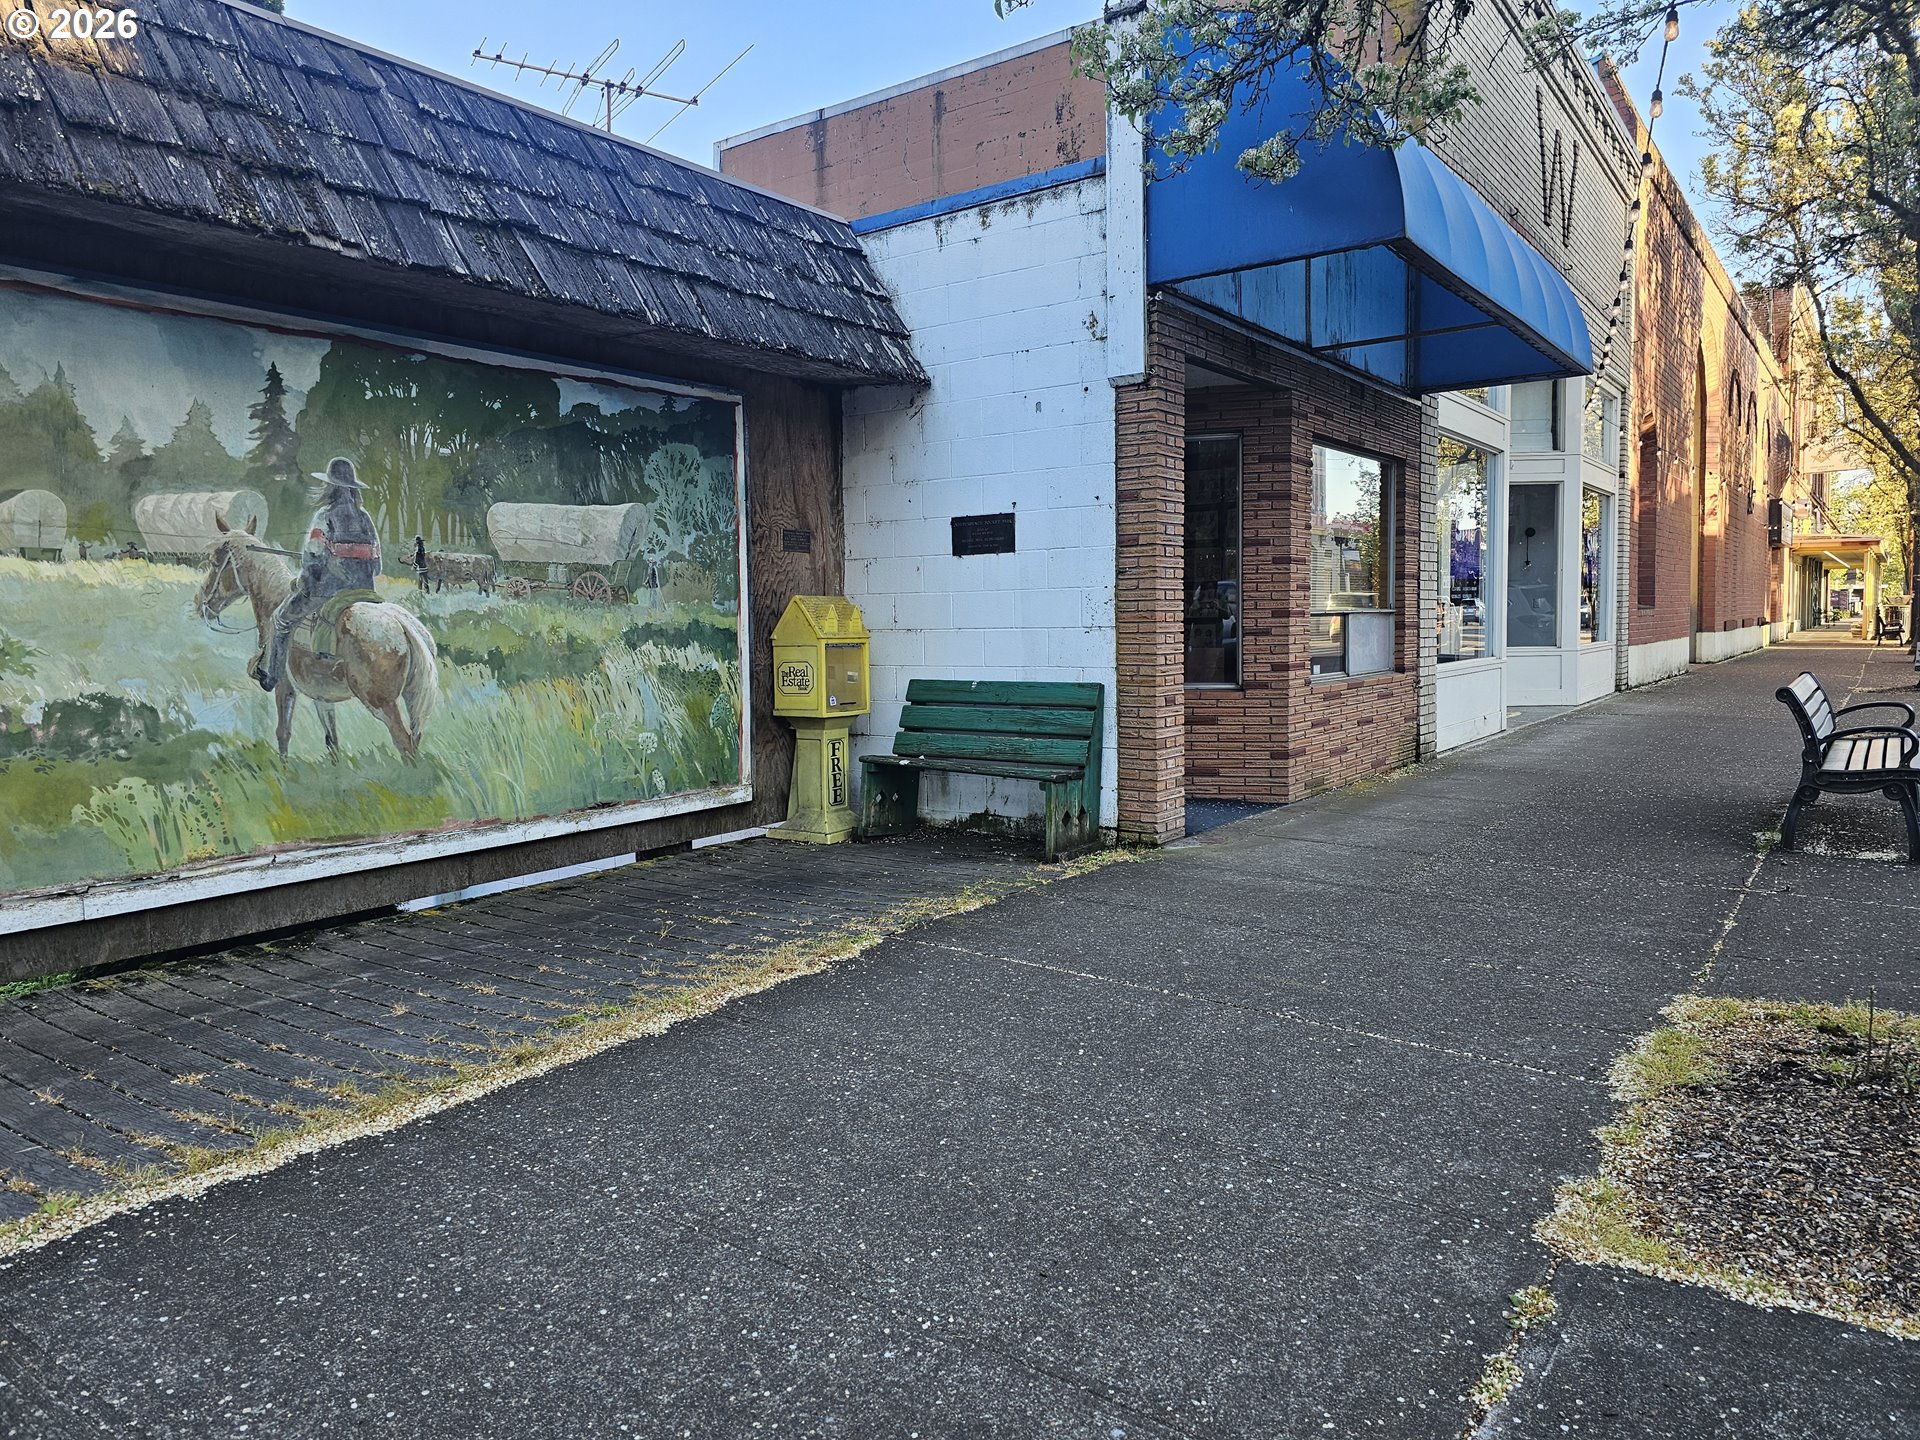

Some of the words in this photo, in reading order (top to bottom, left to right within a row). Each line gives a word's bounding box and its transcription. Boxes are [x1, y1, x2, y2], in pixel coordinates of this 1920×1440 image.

[788, 665, 809, 678] Real
[781, 676, 811, 688] Estate
[830, 741, 843, 805] FREE
